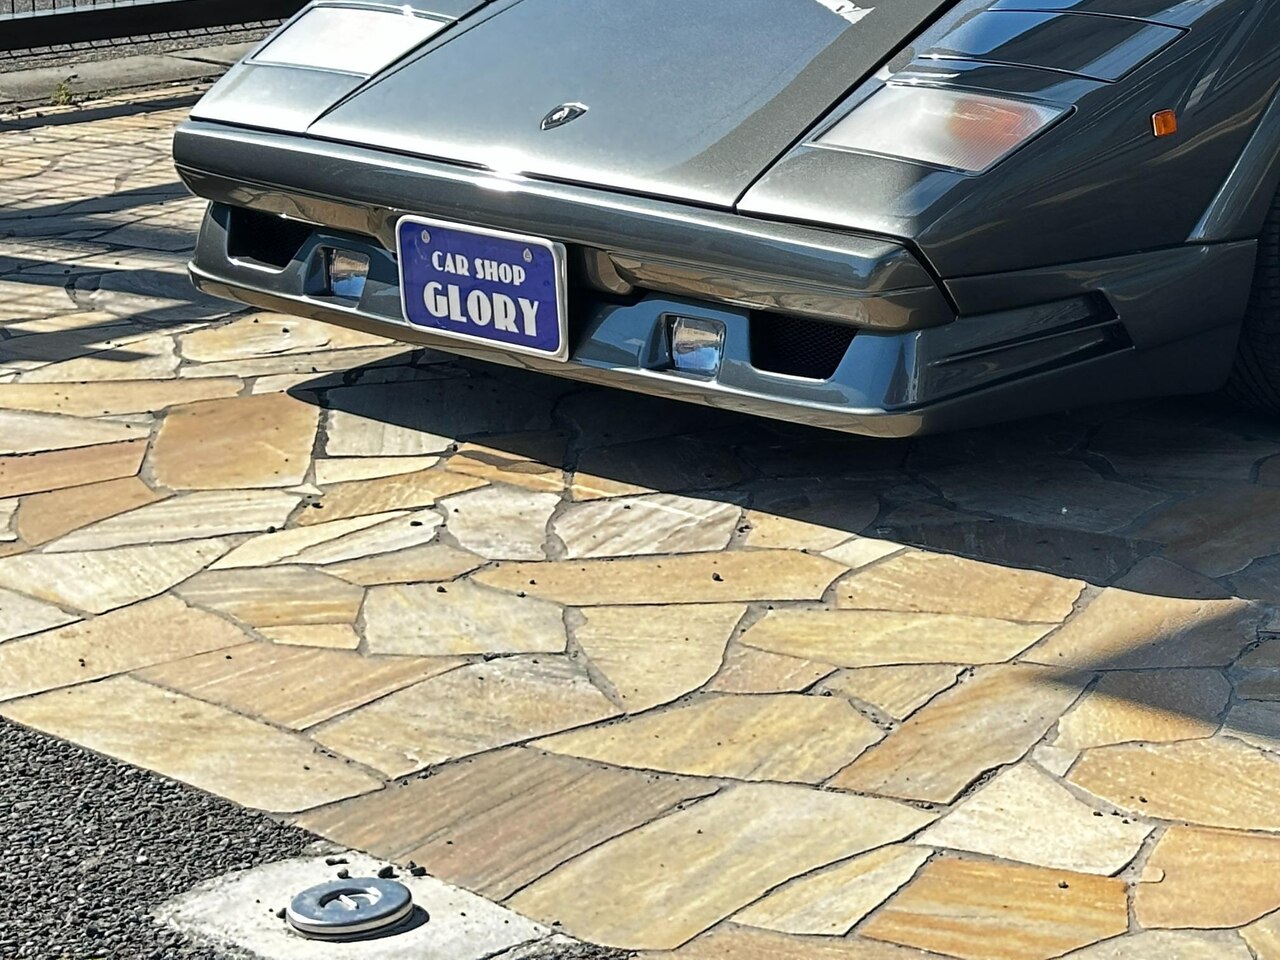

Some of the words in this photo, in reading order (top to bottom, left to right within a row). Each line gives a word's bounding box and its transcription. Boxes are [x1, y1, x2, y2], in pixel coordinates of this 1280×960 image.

[431, 250, 470, 277] CAR
[474, 257, 526, 286] SHOP
[423, 281, 540, 337] GLORY
